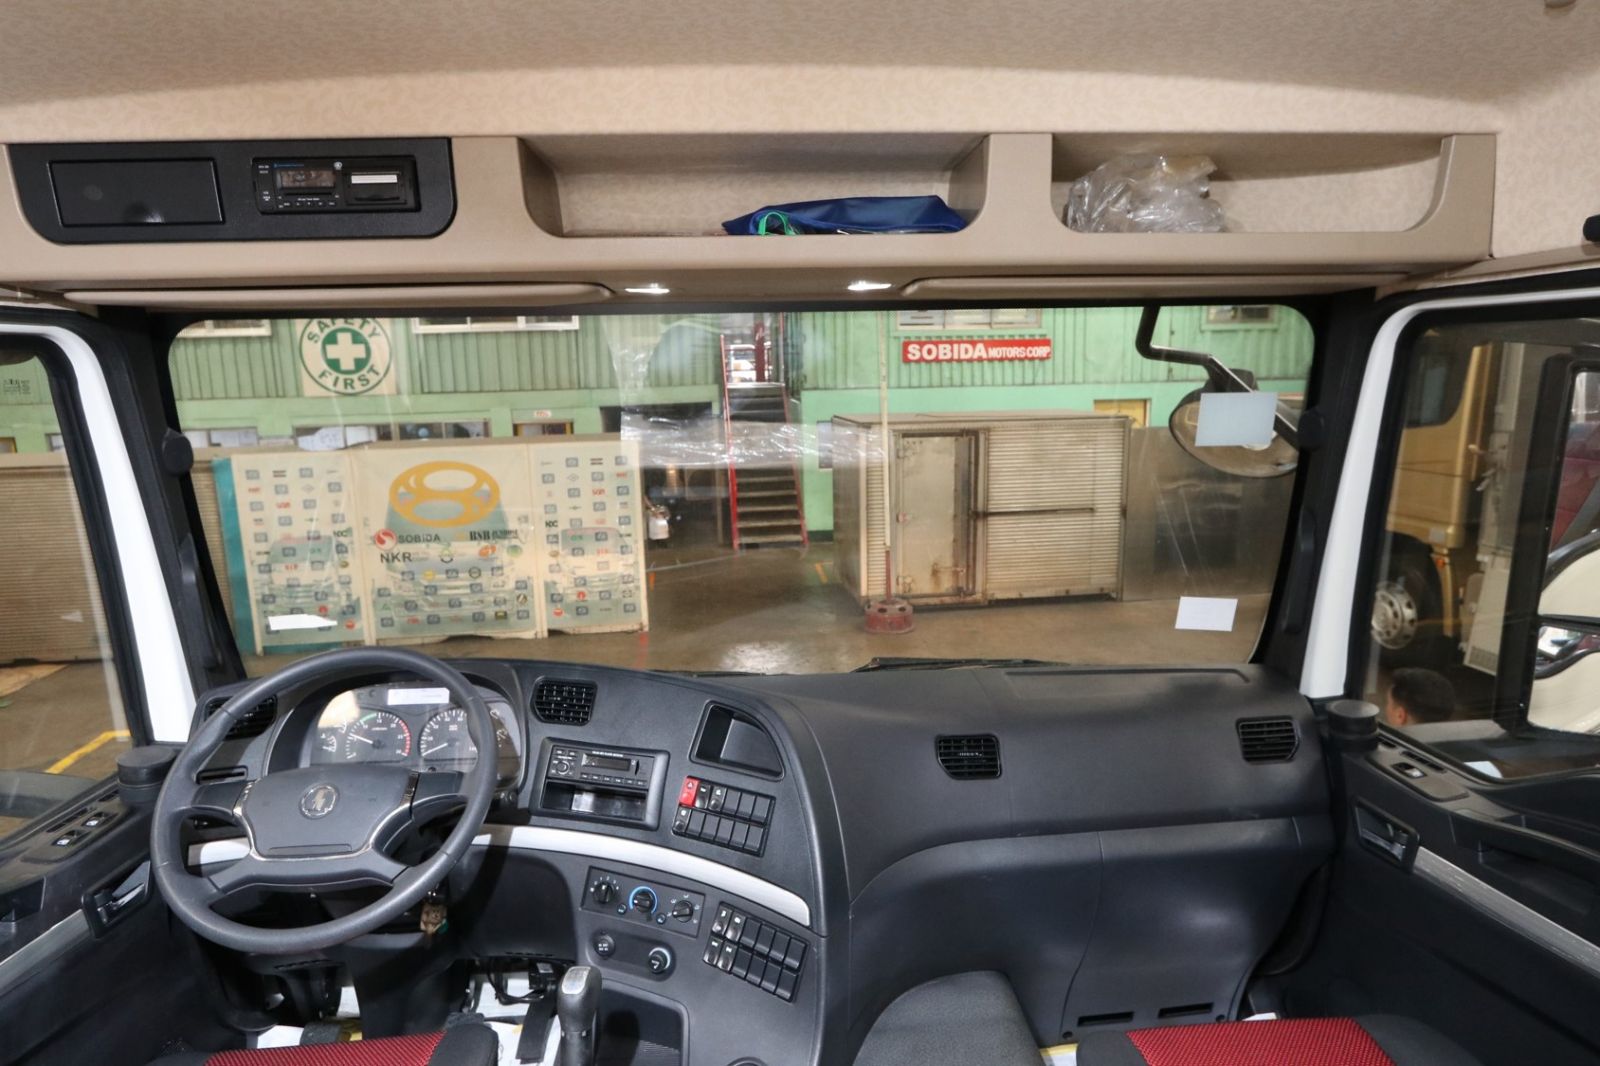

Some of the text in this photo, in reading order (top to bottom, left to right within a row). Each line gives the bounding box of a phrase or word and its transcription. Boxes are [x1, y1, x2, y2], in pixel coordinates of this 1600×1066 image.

[907, 343, 987, 360] SOBIDA
[988, 346, 1026, 358] MOTORS
[318, 364, 380, 390] FIRST
[380, 551, 412, 563] NKR
